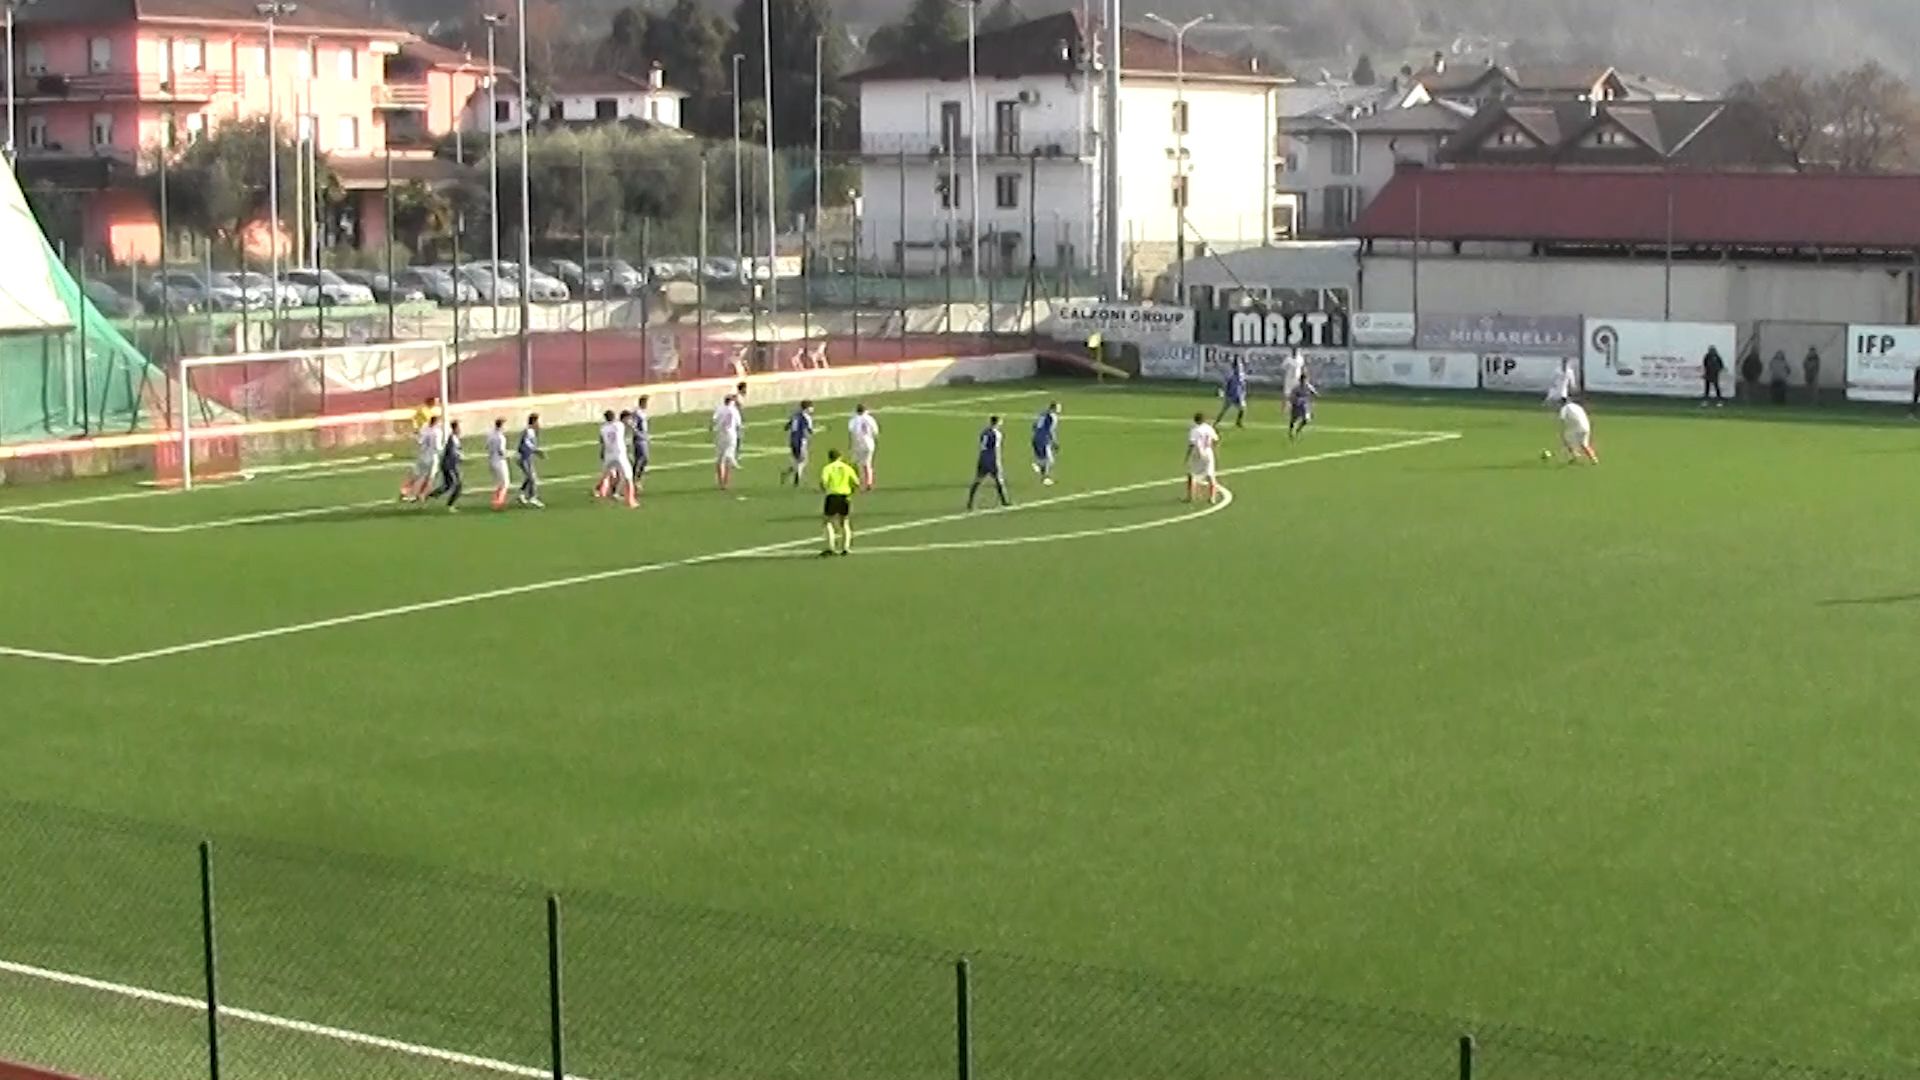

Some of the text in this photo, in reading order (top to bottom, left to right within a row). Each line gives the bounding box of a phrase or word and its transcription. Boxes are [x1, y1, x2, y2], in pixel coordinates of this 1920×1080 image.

[1131, 310, 1184, 323] GROUP
[1858, 335, 1896, 353] IFP
[1486, 357, 1516, 375] IFP
